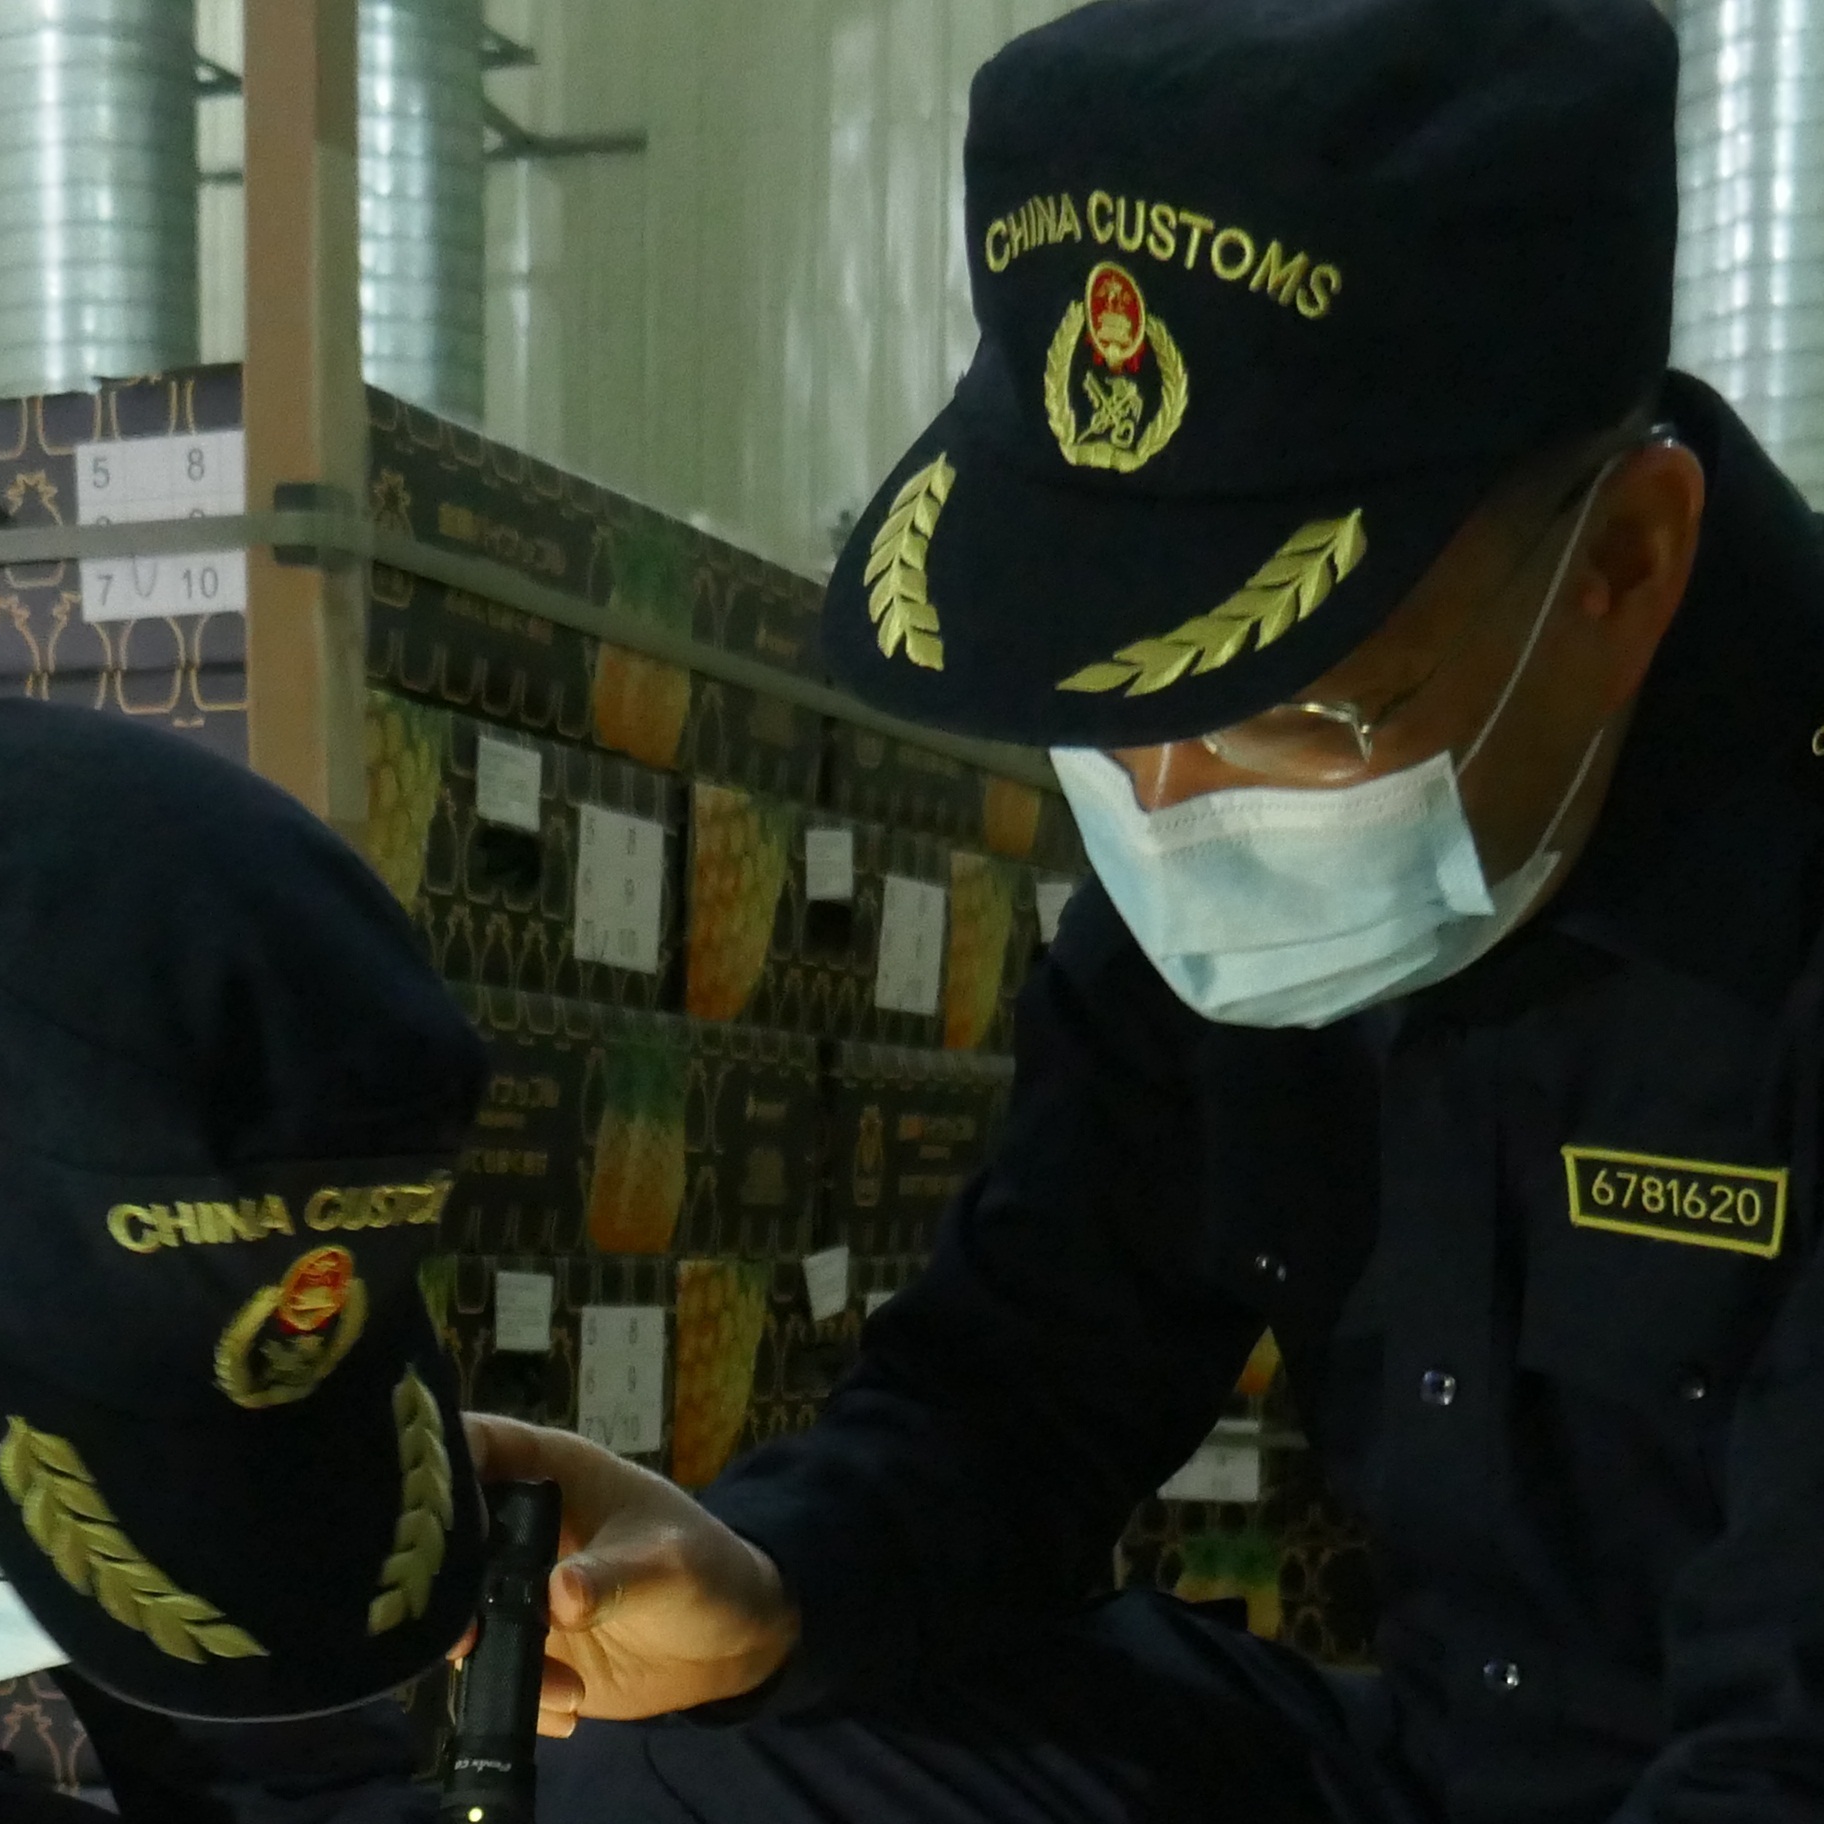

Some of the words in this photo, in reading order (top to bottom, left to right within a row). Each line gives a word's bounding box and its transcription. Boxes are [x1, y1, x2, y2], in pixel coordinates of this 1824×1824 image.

[985, 193, 1082, 272] CHINA
[1086, 190, 1342, 319] CUSTOMS
[92, 456, 110, 489] 5
[187, 448, 205, 481] 8
[97, 573, 114, 606] 7
[183, 566, 218, 600] 10
[106, 1194, 296, 1253] CHINA
[1591, 1167, 1762, 1227] 6781620
